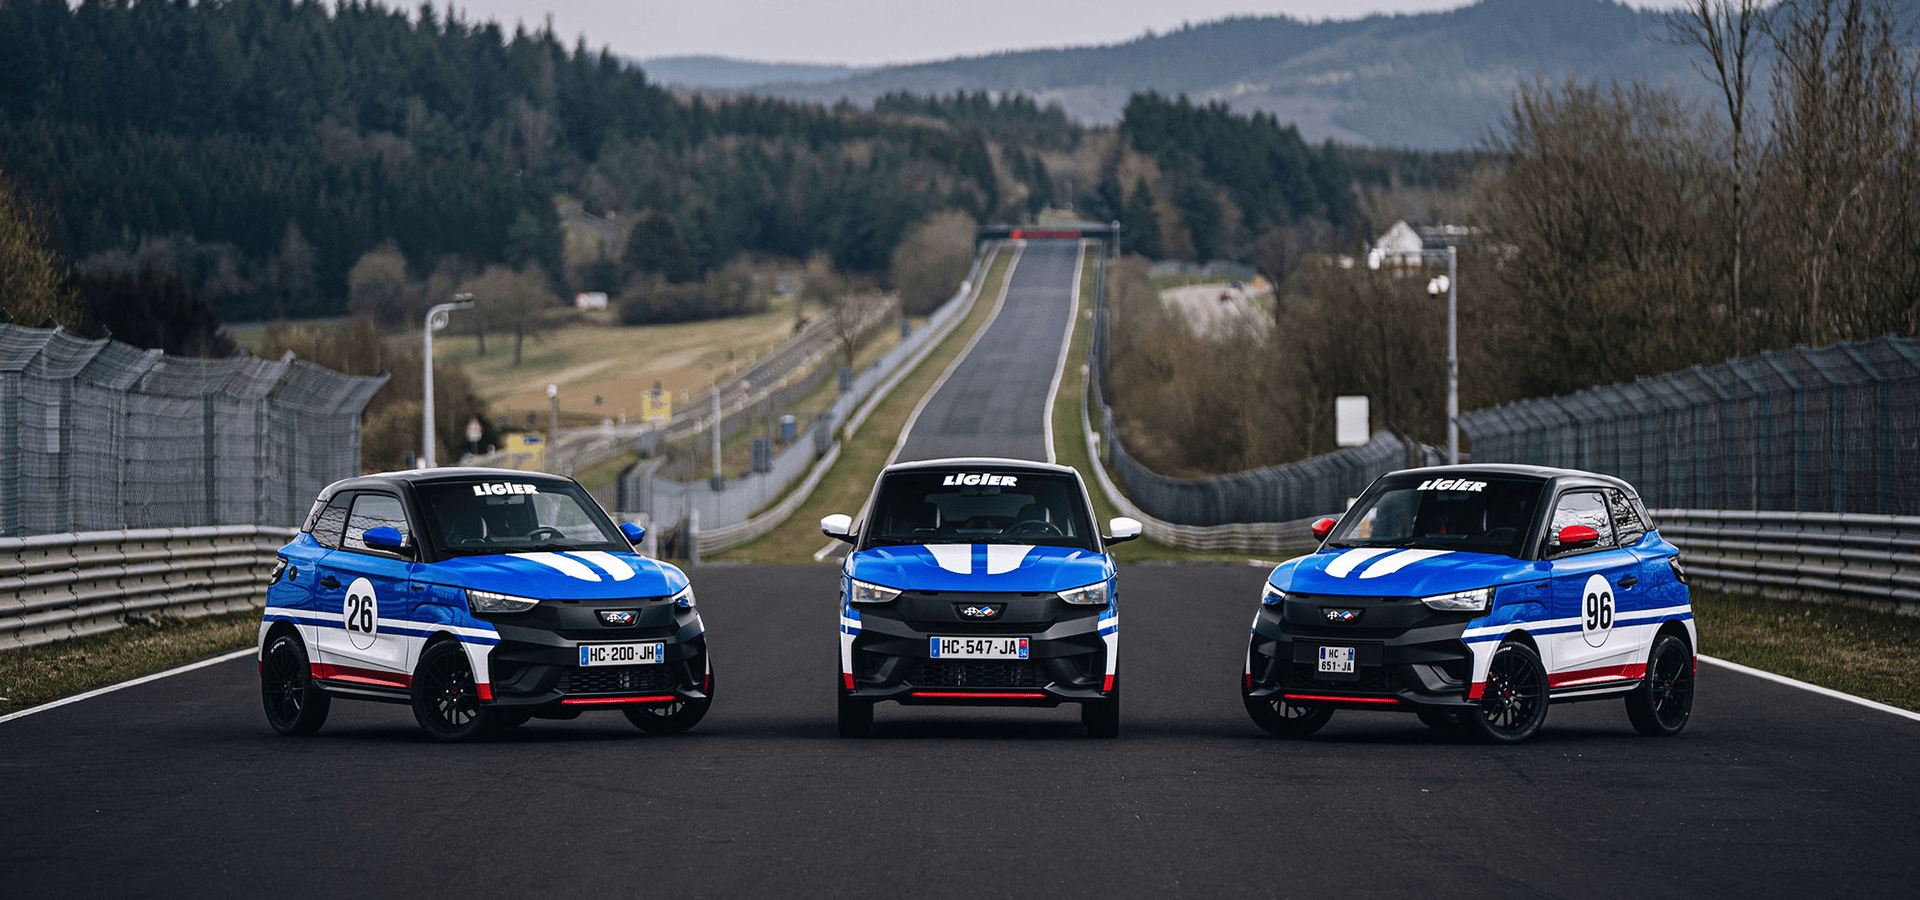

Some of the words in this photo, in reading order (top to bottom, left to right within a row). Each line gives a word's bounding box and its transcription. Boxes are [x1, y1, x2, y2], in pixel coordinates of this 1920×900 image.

[348, 594, 372, 633] 26
[1586, 591, 1612, 630] 96
[590, 645, 654, 662] HC-200-JH
[942, 639, 1017, 655] HC-547-JA
[1321, 661, 1352, 672] 651-JA
